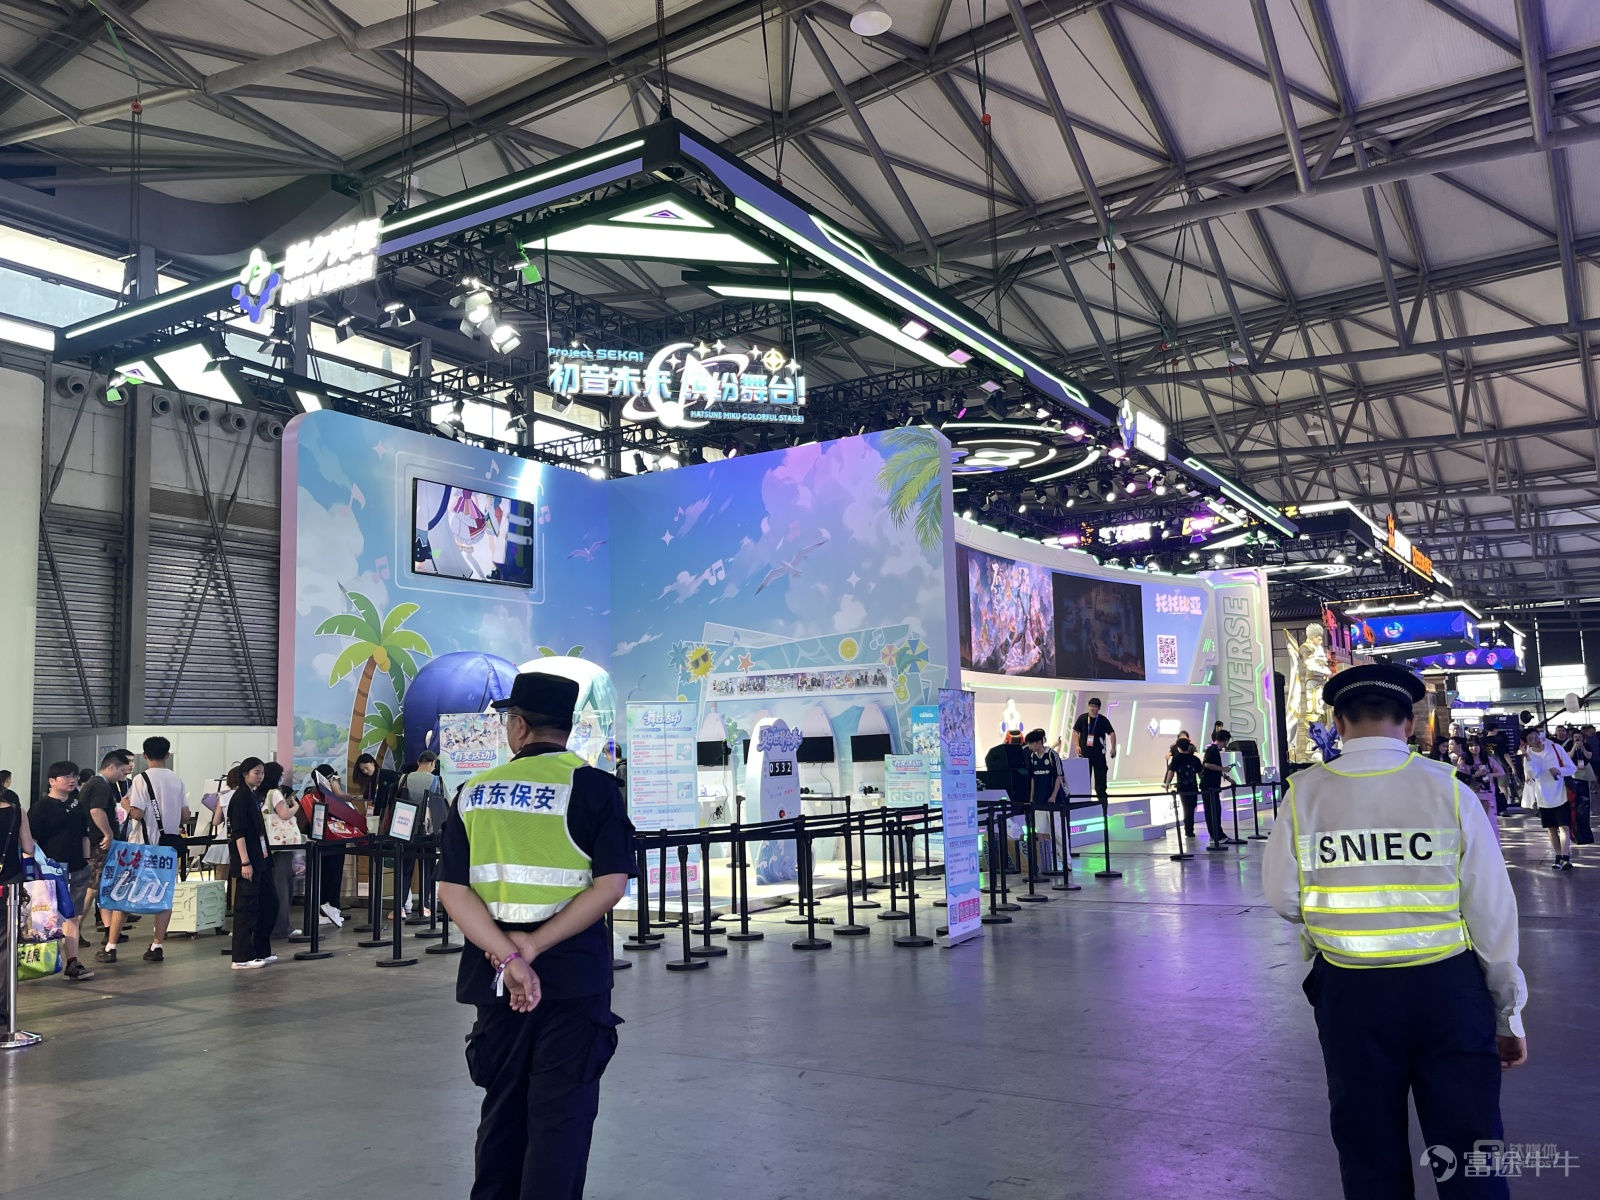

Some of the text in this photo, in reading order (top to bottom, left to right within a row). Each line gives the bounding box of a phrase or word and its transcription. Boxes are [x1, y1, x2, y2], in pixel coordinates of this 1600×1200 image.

[548, 347, 645, 363] Project SEKAI
[548, 360, 672, 398] 初音未来
[690, 410, 723, 419] HATSUNE
[723, 412, 741, 421] MIKU
[742, 412, 778, 422] COLORFUL
[769, 762, 792, 774] 0532
[466, 783, 556, 810] 浦东保安
[1319, 832, 1433, 864] SNIEC
